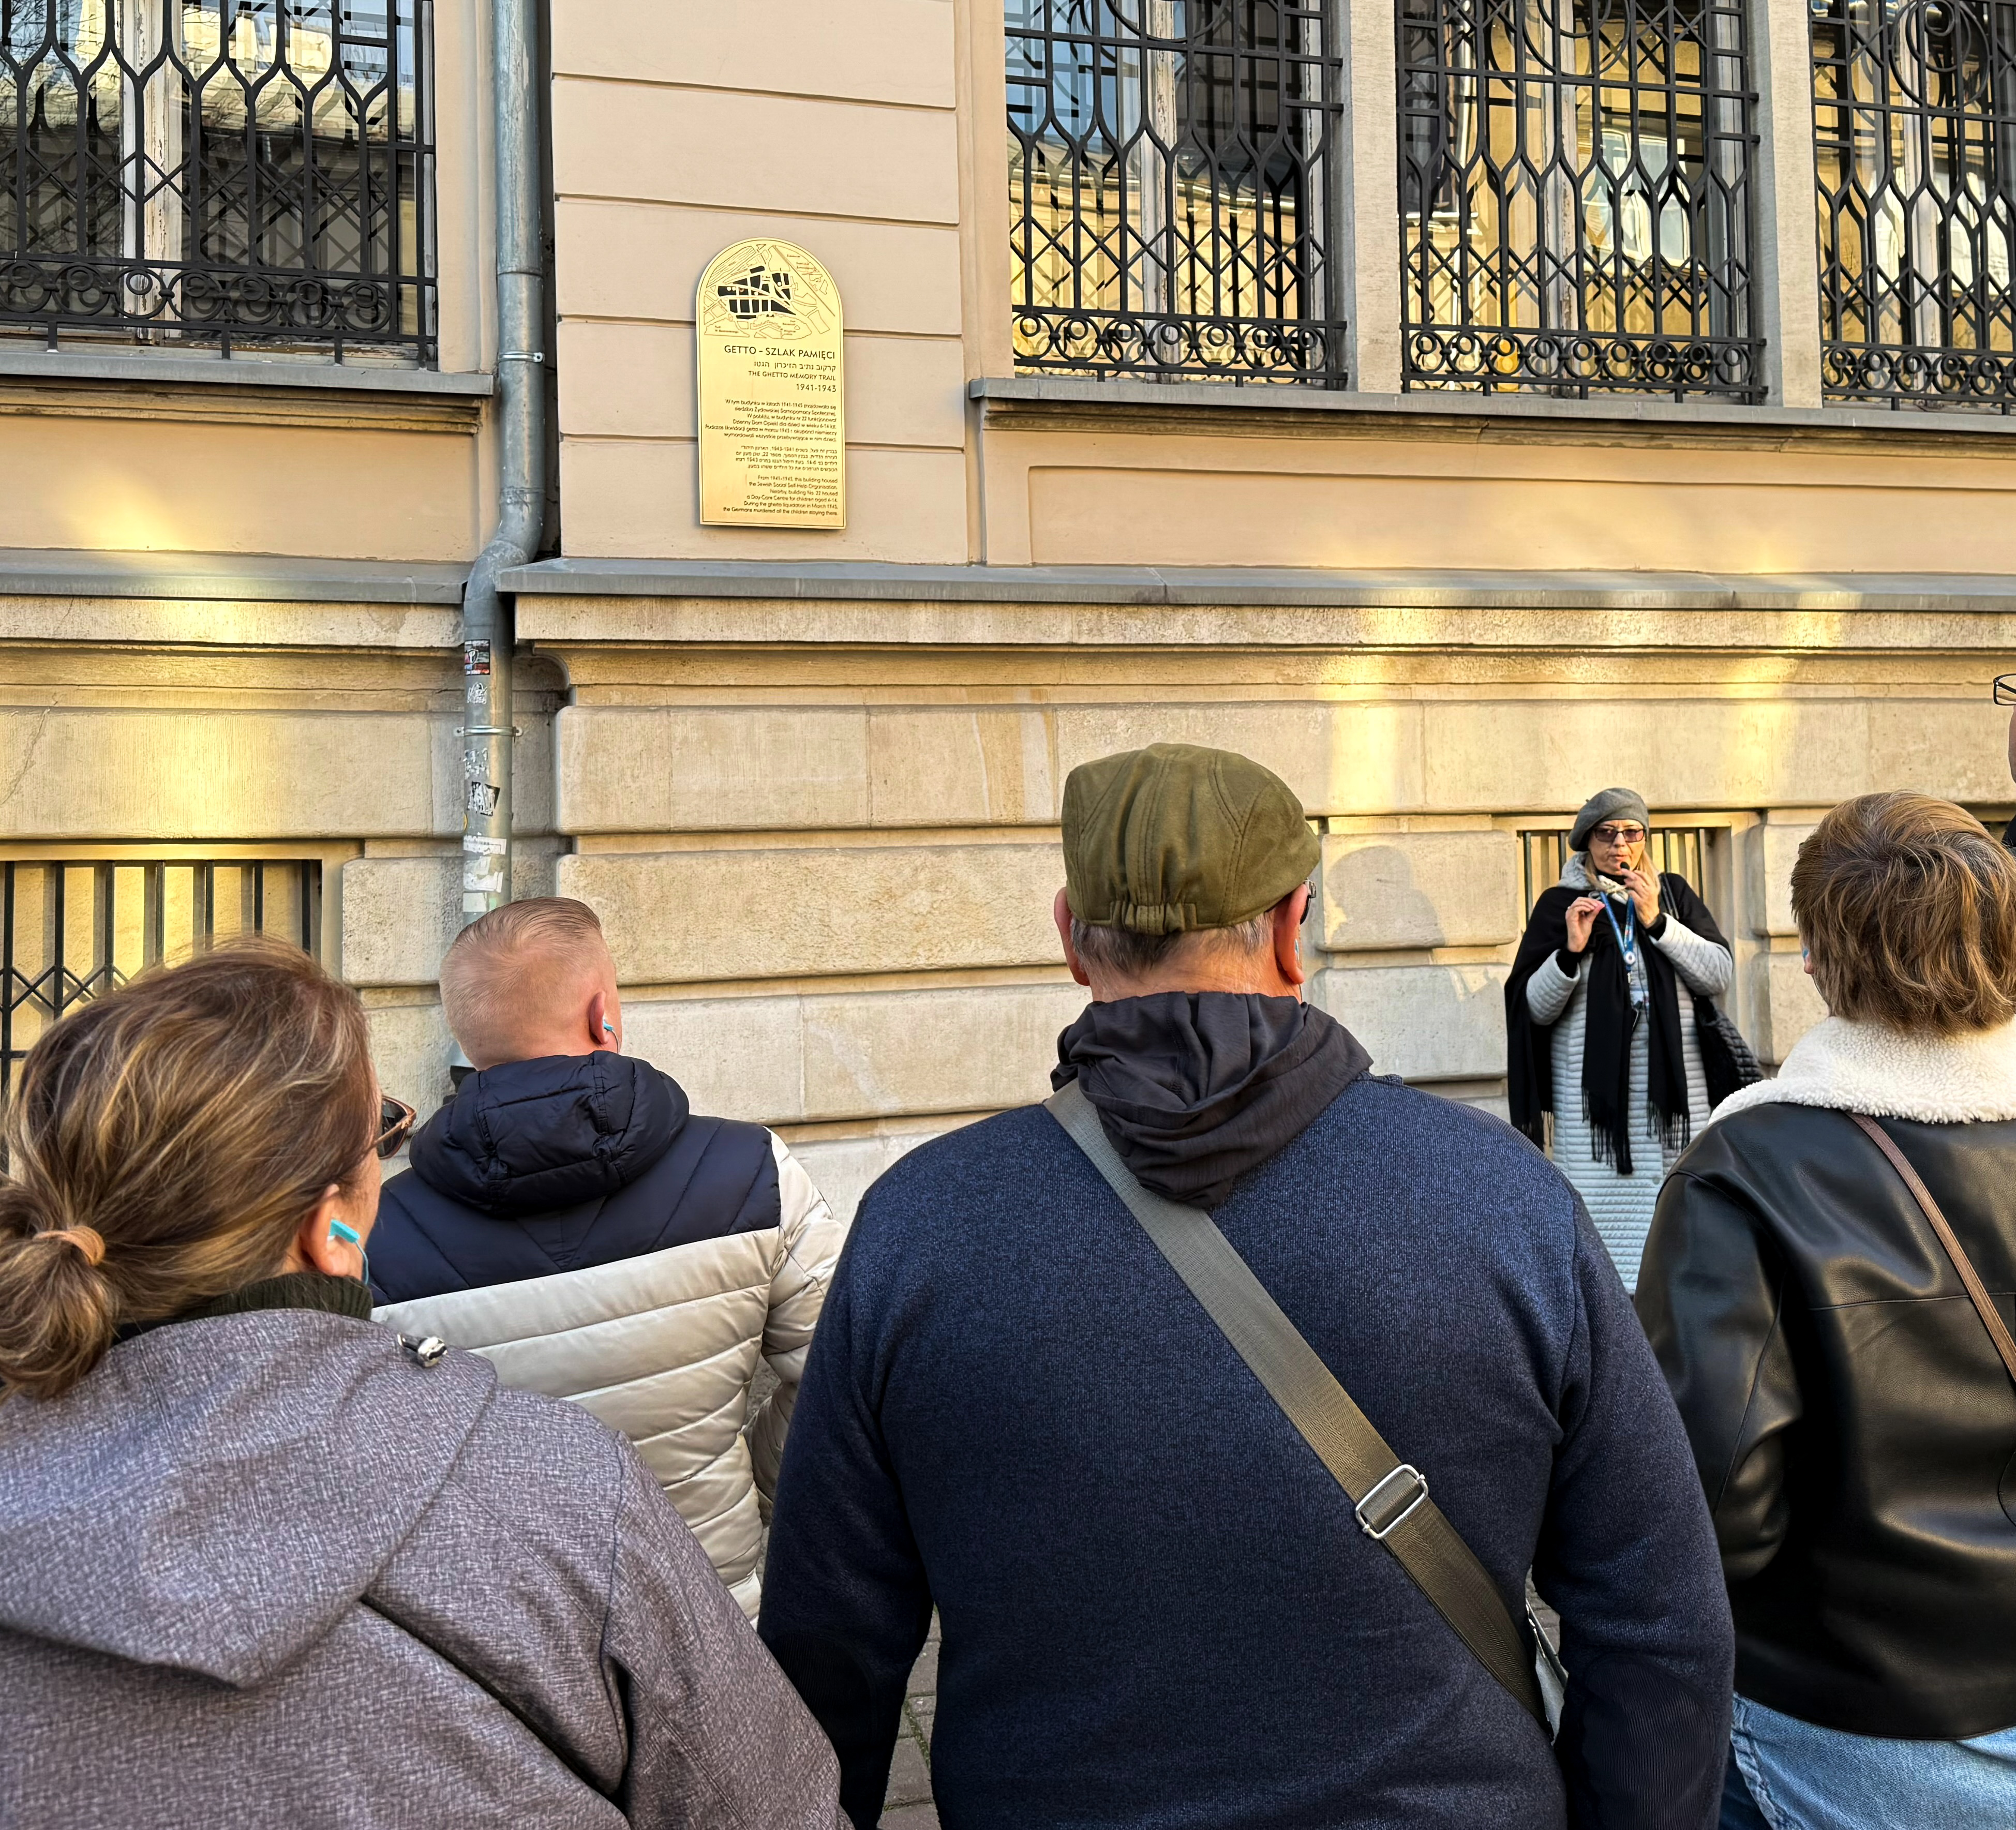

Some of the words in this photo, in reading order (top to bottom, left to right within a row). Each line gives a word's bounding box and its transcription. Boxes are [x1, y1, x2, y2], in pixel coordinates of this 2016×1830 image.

[724, 344, 756, 354] GETTO
[765, 347, 796, 357] SZLAK
[798, 349, 834, 360] PAMIĘCI
[796, 383, 836, 392] 1941-1943
